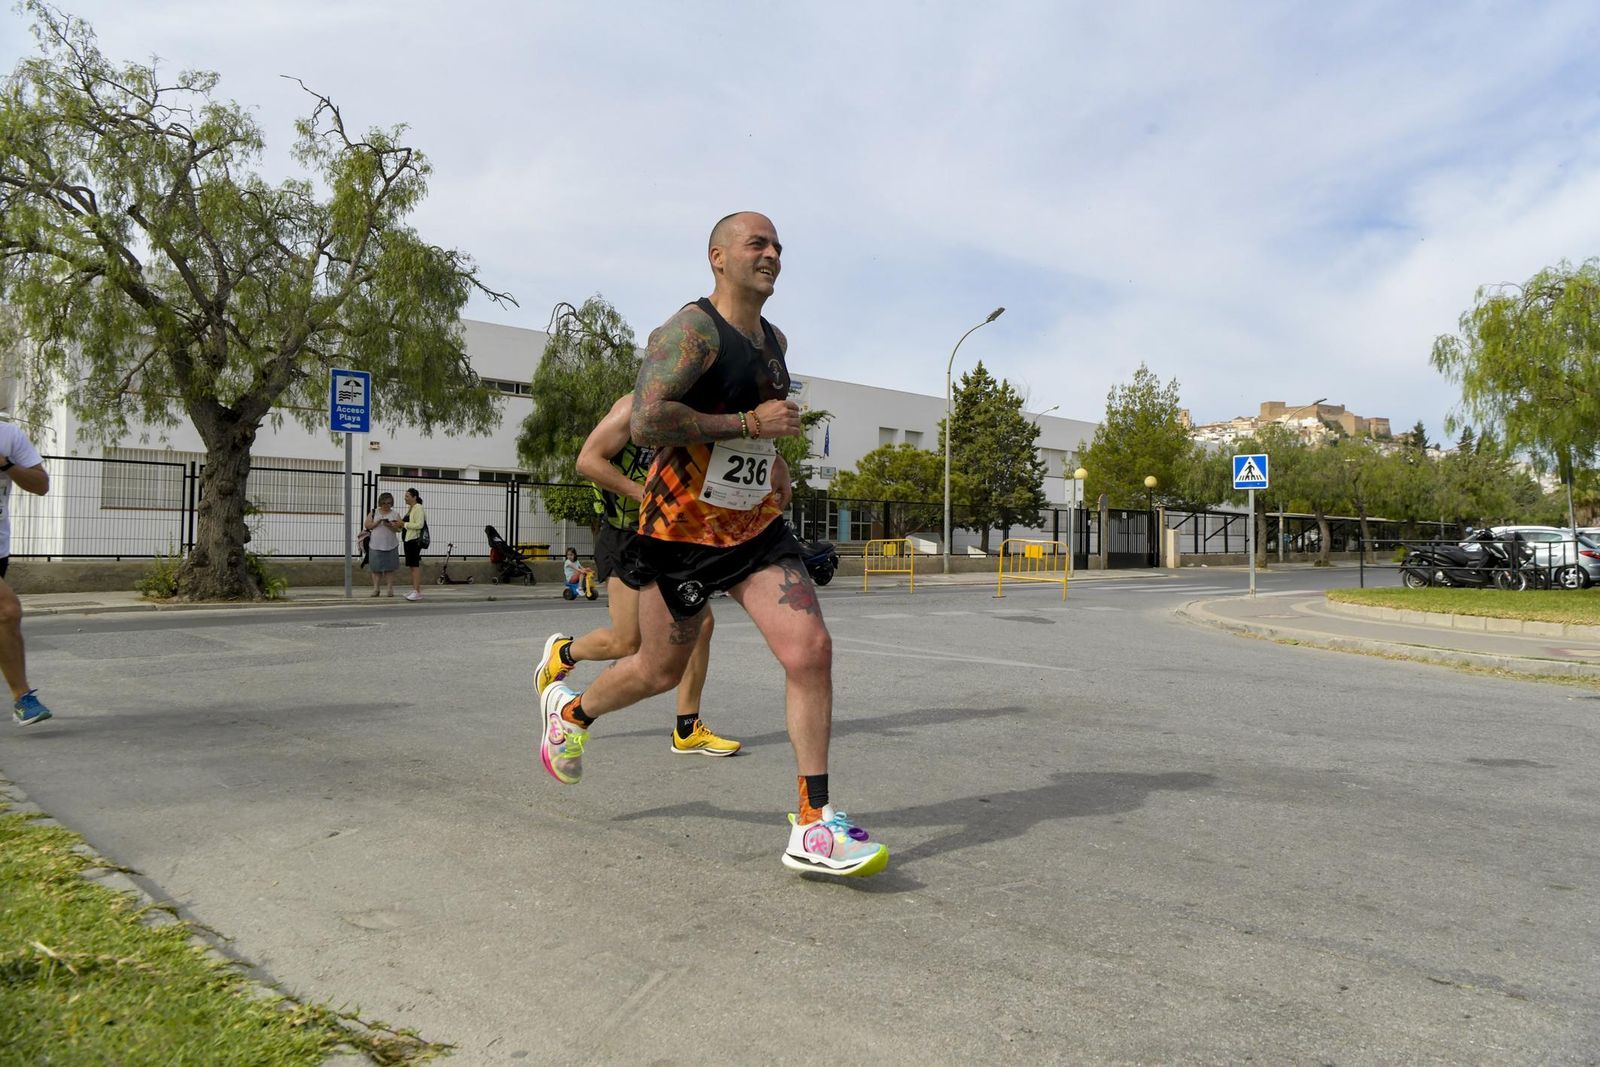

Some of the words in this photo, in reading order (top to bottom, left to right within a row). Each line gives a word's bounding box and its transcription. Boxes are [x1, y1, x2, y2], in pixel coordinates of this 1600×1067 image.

[336, 405, 365, 414] Acceso
[339, 413, 361, 422] Playa
[722, 455, 768, 486] 236
